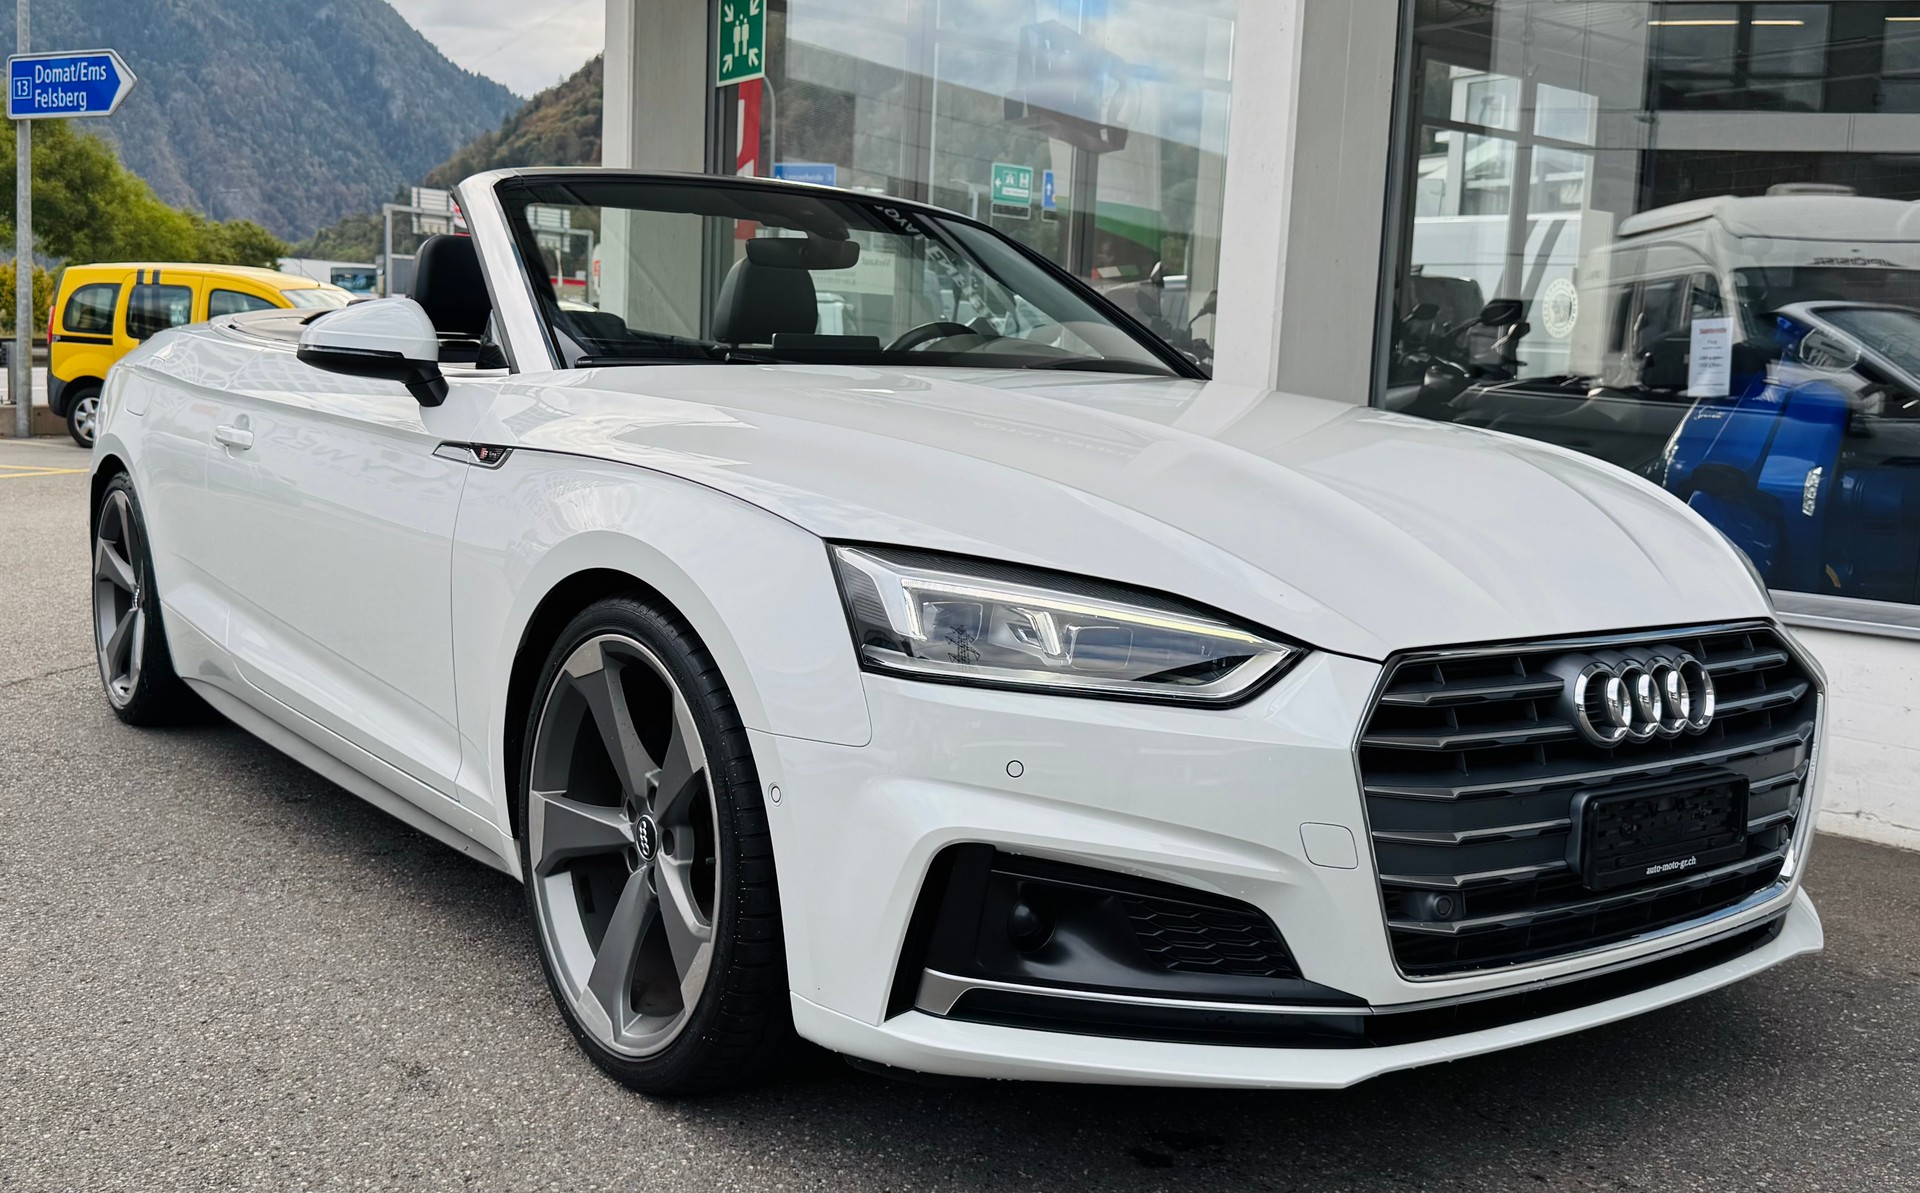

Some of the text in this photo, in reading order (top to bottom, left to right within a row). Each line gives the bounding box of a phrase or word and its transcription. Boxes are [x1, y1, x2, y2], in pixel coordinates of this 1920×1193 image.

[35, 61, 107, 84] Domat/Ems
[16, 80, 29, 96] 13
[34, 86, 87, 111] Felsberg
[1645, 855, 1697, 875] auto-moto-gr.ch
